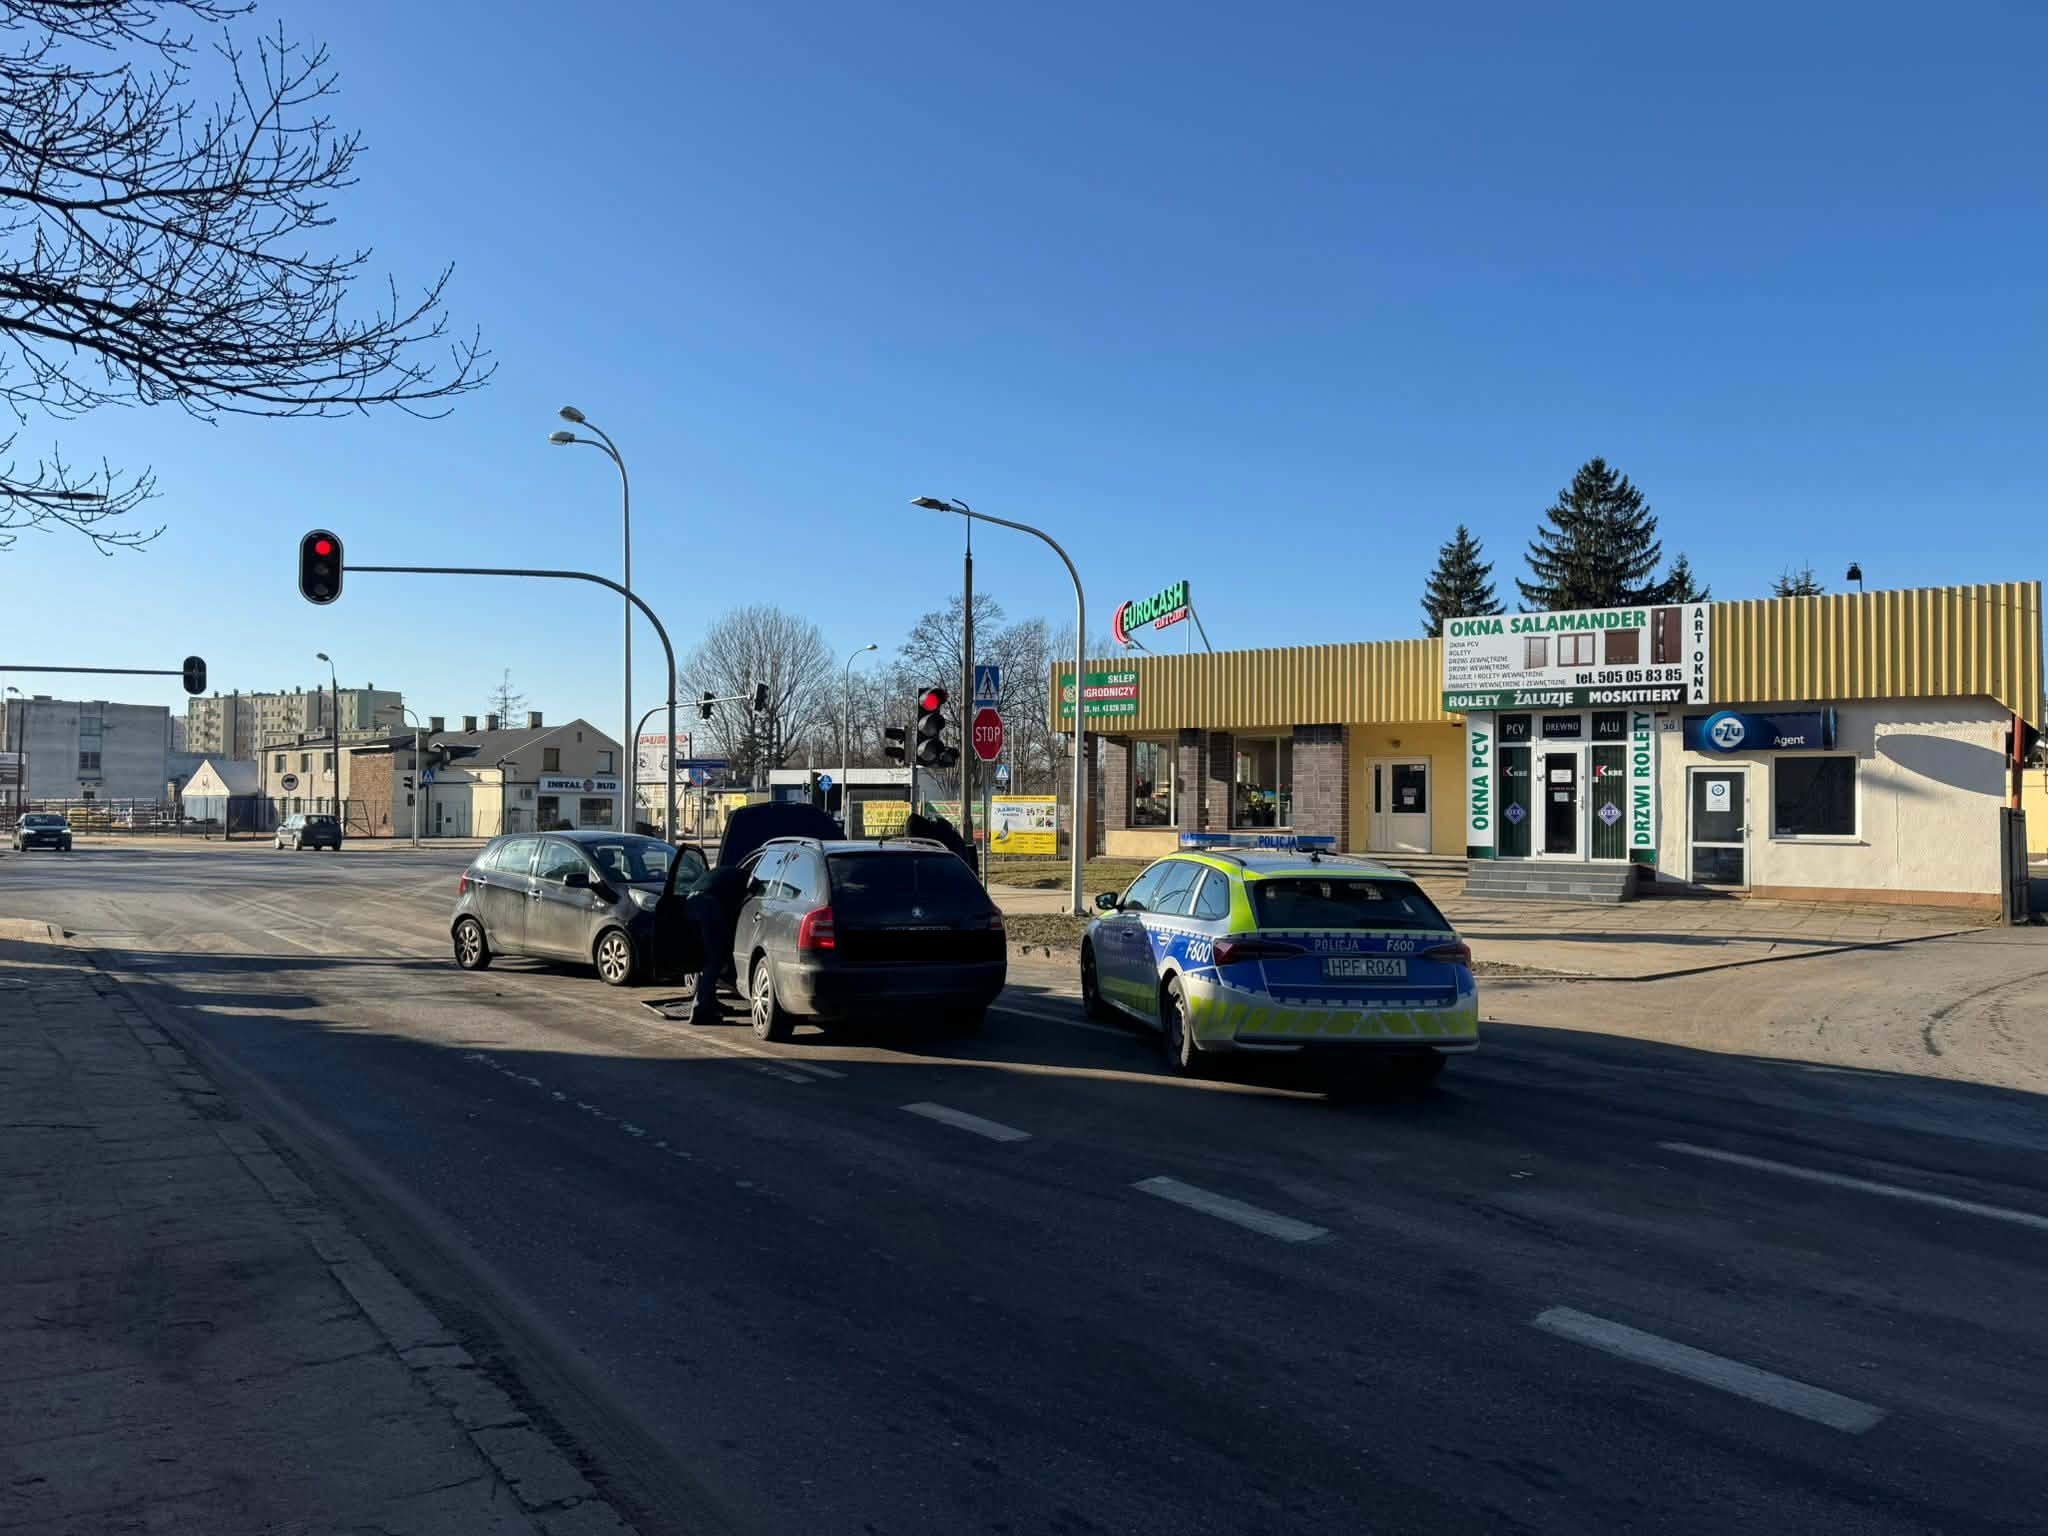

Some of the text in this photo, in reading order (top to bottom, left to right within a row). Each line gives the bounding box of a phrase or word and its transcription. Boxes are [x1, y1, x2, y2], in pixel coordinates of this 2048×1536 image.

[1123, 580, 1184, 632] EUROCASH
[1450, 610, 1646, 637] OKNA SALAMANDER
[1694, 607, 1704, 700] ART OKNA
[1108, 674, 1136, 684] SKLEP
[1576, 668, 1682, 684] tel. 505 05 83 85
[1083, 686, 1134, 698] GRODNICZY
[1448, 689, 1681, 708] ROLETY ŻALUZJE MOSKITIERY
[1506, 724, 1524, 735] PCV
[1545, 722, 1578, 732] DREWNO
[1600, 721, 1620, 733] ALU
[975, 731, 1001, 742] STOP
[1773, 735, 1805, 746] Agent
[1472, 731, 1489, 830] OKNA PCV
[1634, 711, 1650, 845] DRZWI ROLETY
[547, 781, 616, 790] INSTAL BUD
[1258, 835, 1297, 849] POLICJA
[1314, 938, 1360, 951] POLICJA
[1386, 939, 1415, 952] F600
[1185, 940, 1212, 963] F600
[1331, 959, 1401, 976] HPF R061
